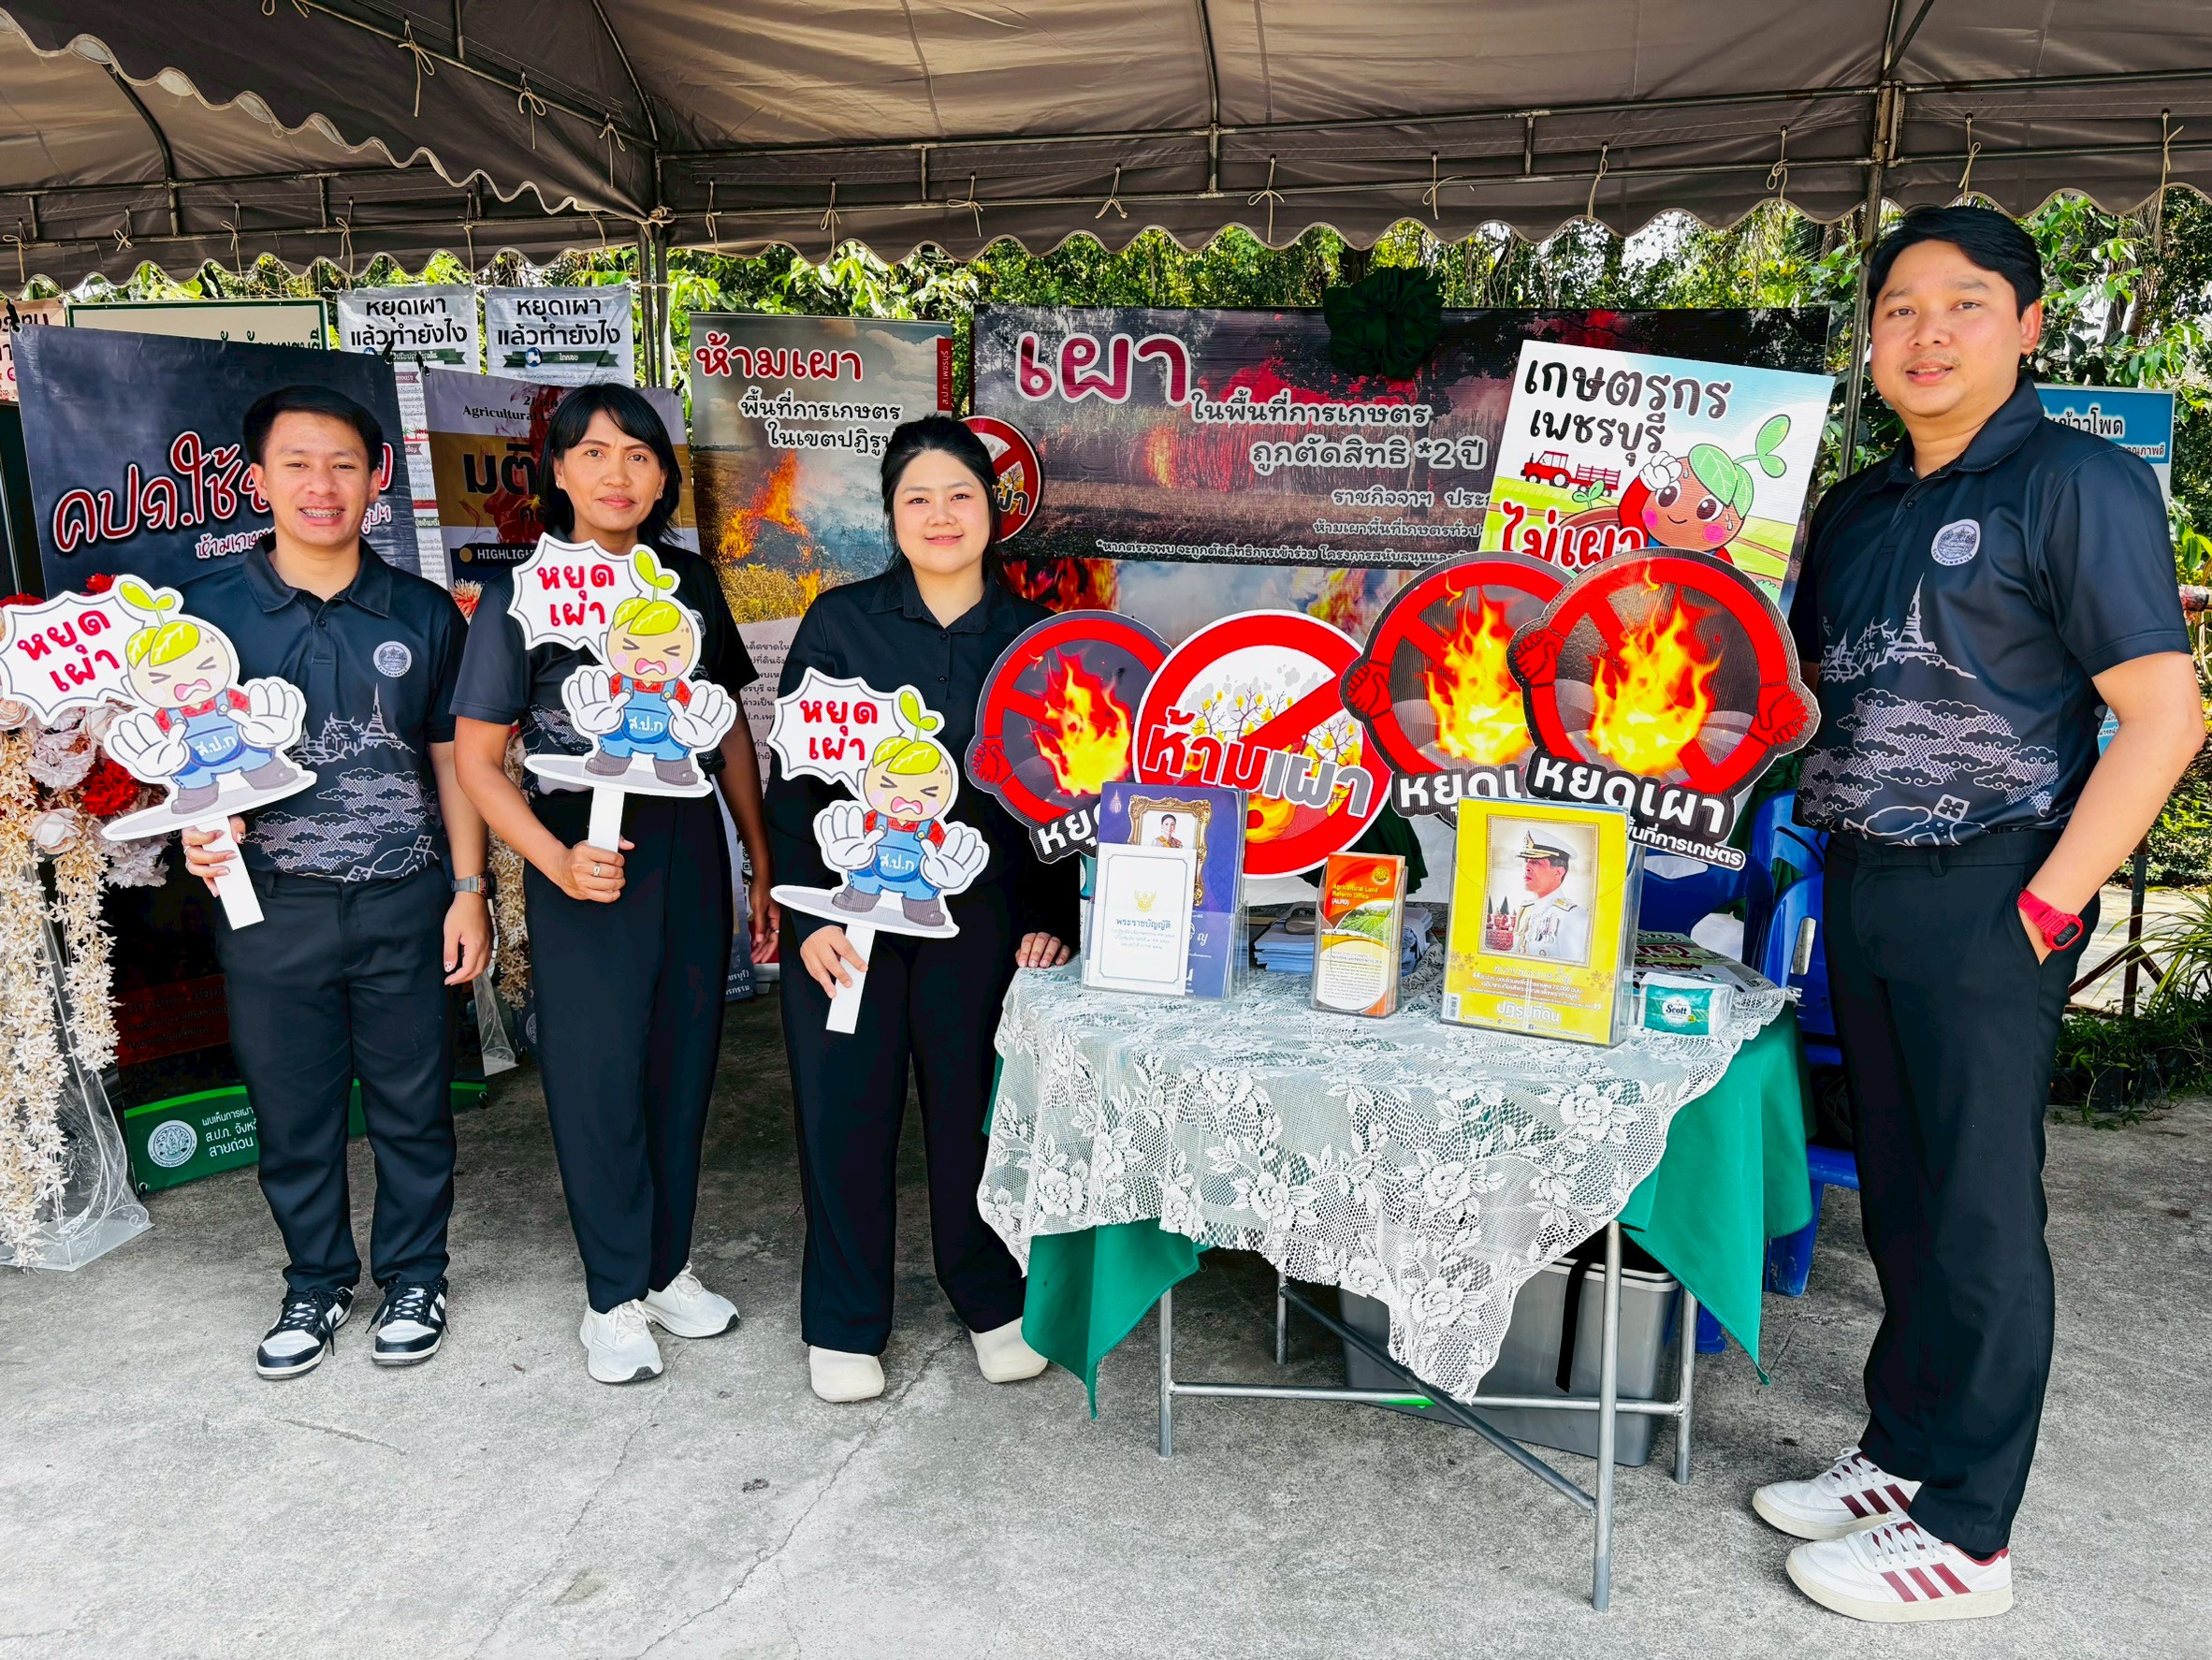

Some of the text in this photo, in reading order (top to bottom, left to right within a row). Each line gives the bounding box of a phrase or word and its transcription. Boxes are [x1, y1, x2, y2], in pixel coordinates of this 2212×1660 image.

[366, 297, 446, 323] หยุดเผา
[517, 298, 602, 323] หยุดเผา
[351, 319, 468, 347] แล้วทำยังไง
[498, 319, 620, 346] แล้วทำยังไง
[694, 330, 864, 381] ห้ามเผา
[1017, 332, 1191, 406] เผา
[1524, 359, 1732, 419] เกษตรกร
[462, 404, 537, 421] Agricultural
[740, 388, 902, 419] พื้นที่การเกษตร
[1190, 389, 1431, 425] ในพื้นที่การเกษตร
[2052, 406, 2123, 435] ข้าวโพด
[1530, 409, 1666, 467] เพชรบุรี
[1252, 434, 1408, 473] ถูกตัดสิทธิ
[1461, 438, 1486, 467] ปี
[1332, 486, 1433, 506] ราชกิจจาฯ
[1314, 517, 1483, 538] ห้ามเผาพื้นที่เกษตรทั่วป
[1501, 501, 1648, 566] ไม่เผา
[537, 563, 615, 601] หยุด
[549, 601, 605, 627] เผา
[17, 610, 110, 661] หยุด
[50, 648, 120, 692] เผา
[628, 715, 663, 732] ส.ป.ก
[799, 700, 878, 735] หยุด
[197, 735, 236, 757] ส.ป.ก
[808, 736, 866, 761] เผา
[1142, 706, 1374, 818] ห้ามเผา
[880, 855, 915, 871] ส.ป.ก
[1666, 1002, 1687, 1015] Scott
[209, 1136, 255, 1158] สายด่วน
